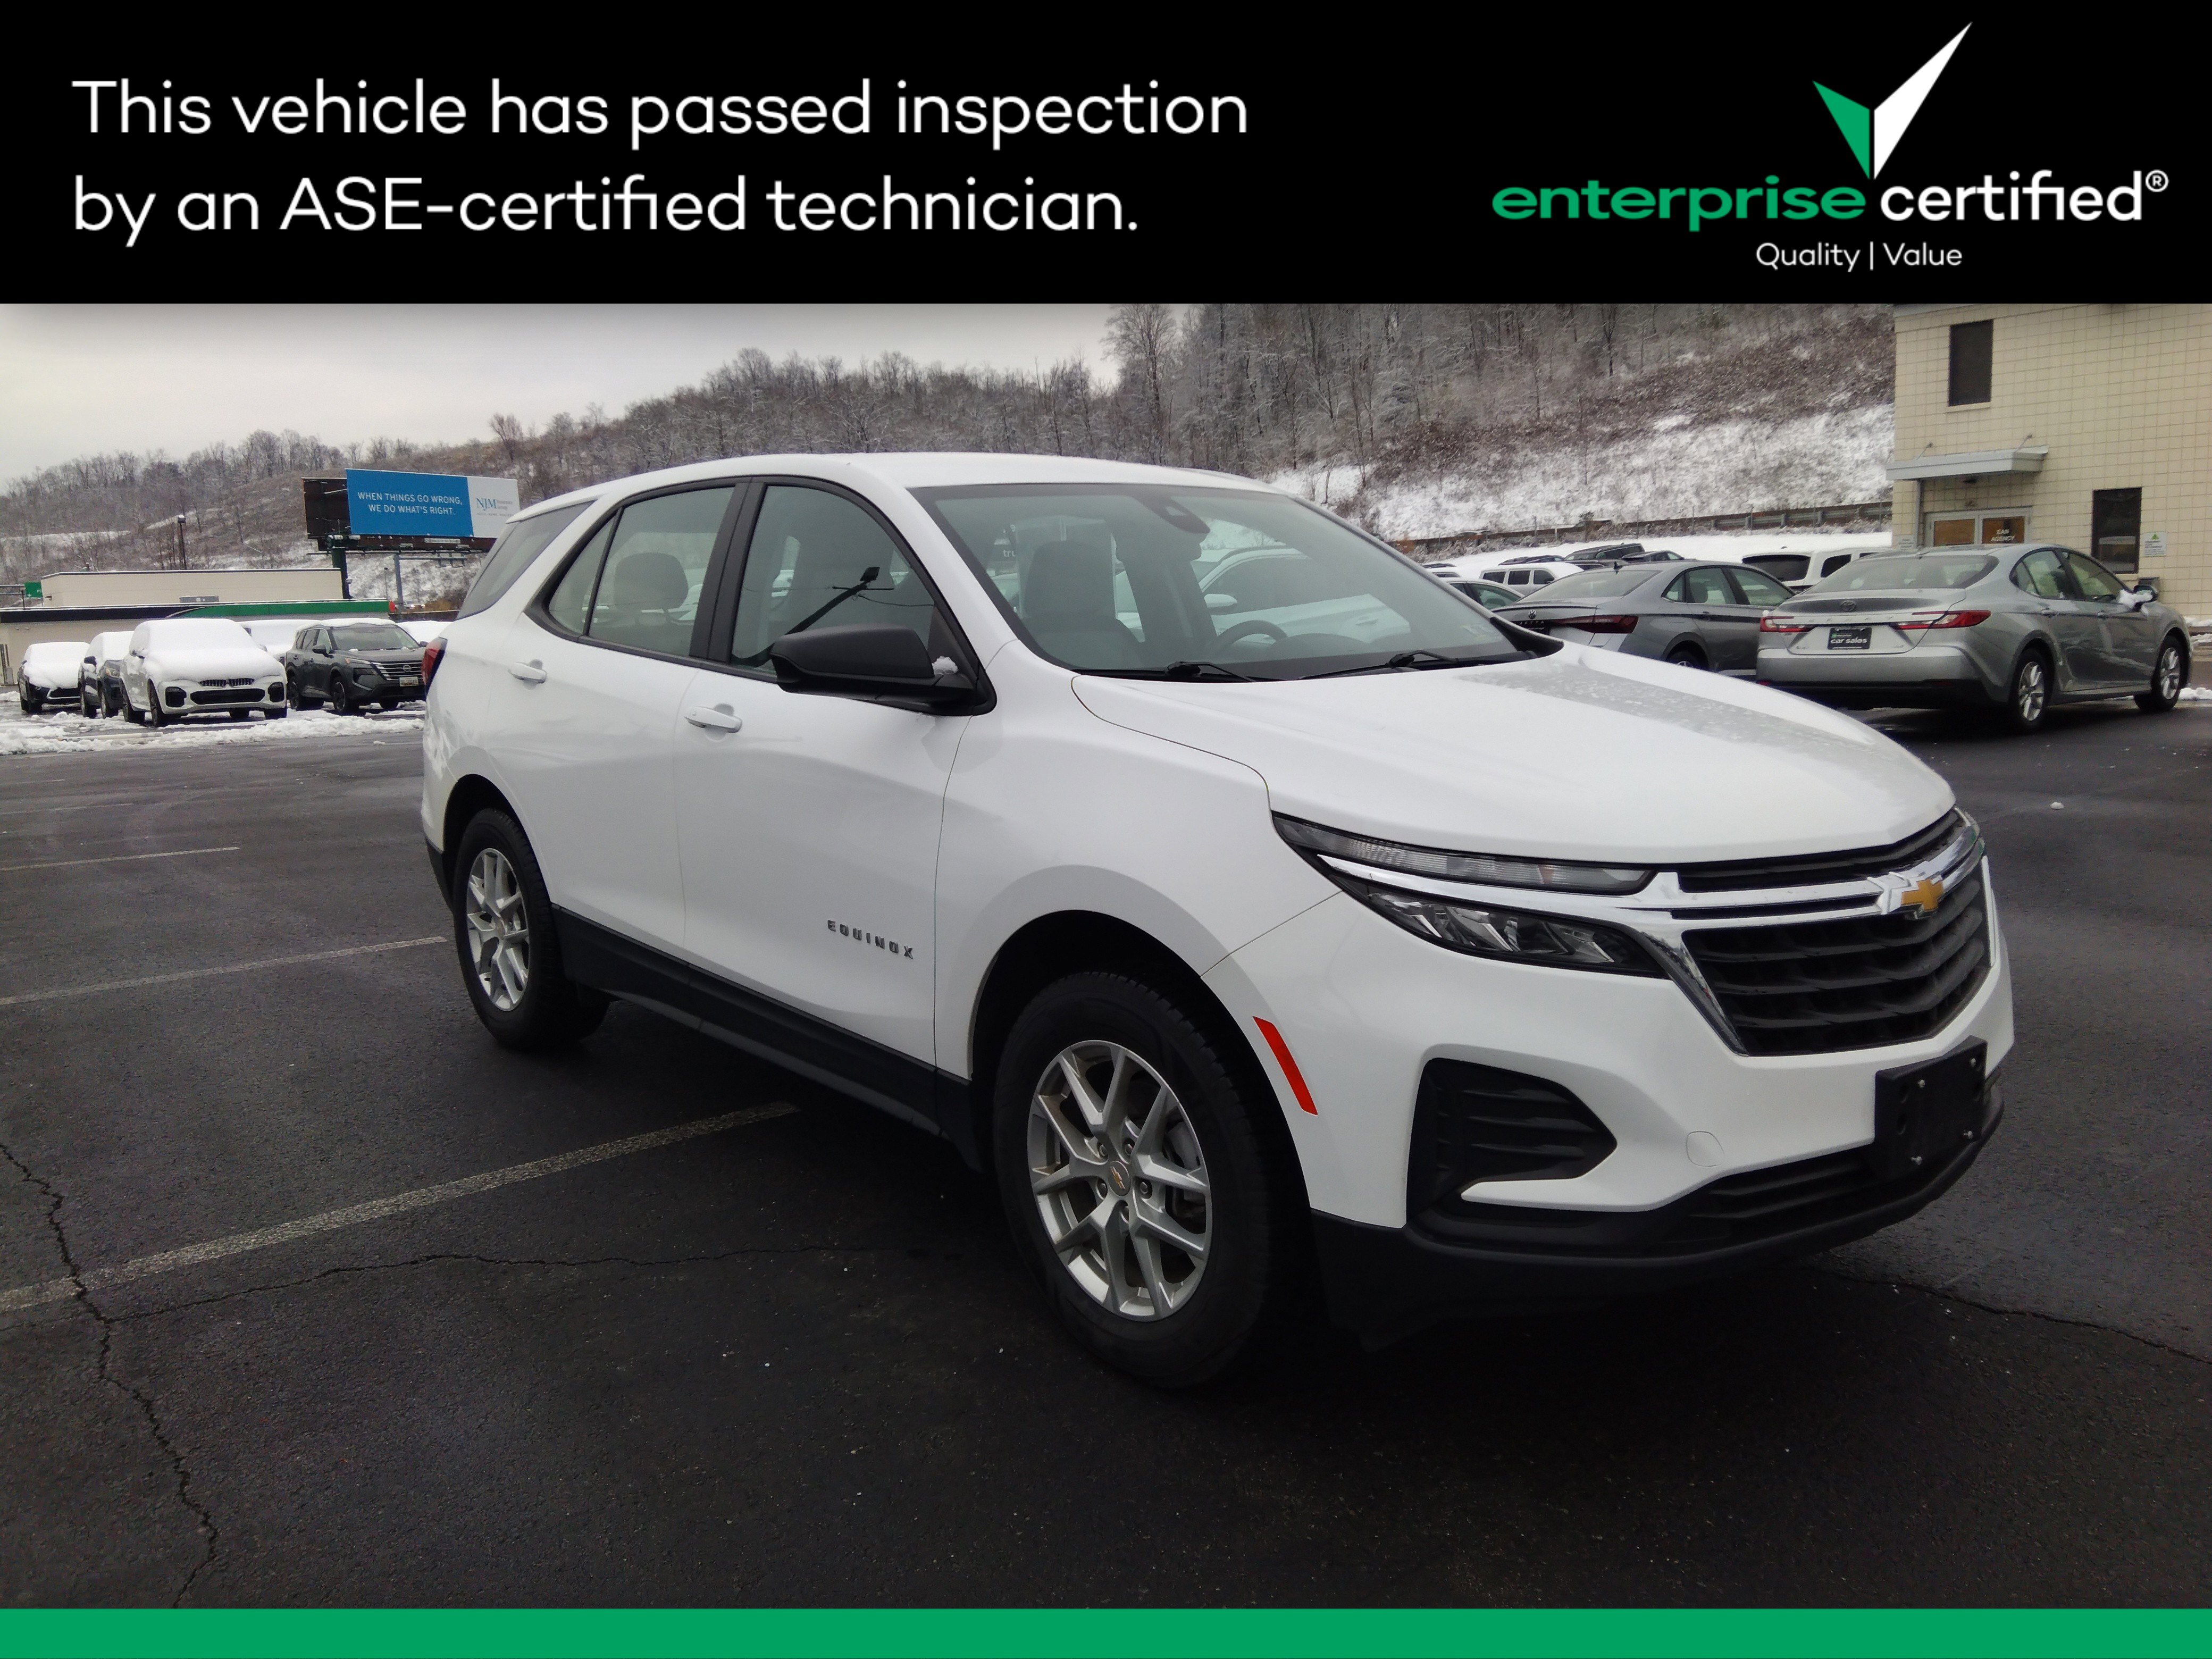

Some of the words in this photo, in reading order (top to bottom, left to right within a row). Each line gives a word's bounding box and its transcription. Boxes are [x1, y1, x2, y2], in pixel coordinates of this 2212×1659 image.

[358, 492, 382, 500] WHEN
[384, 493, 415, 502] THINGS
[431, 496, 463, 505] WRONG,
[476, 498, 497, 510] NJM
[430, 507, 455, 515] RIGHT.
[827, 919, 914, 959] EQUINOX
